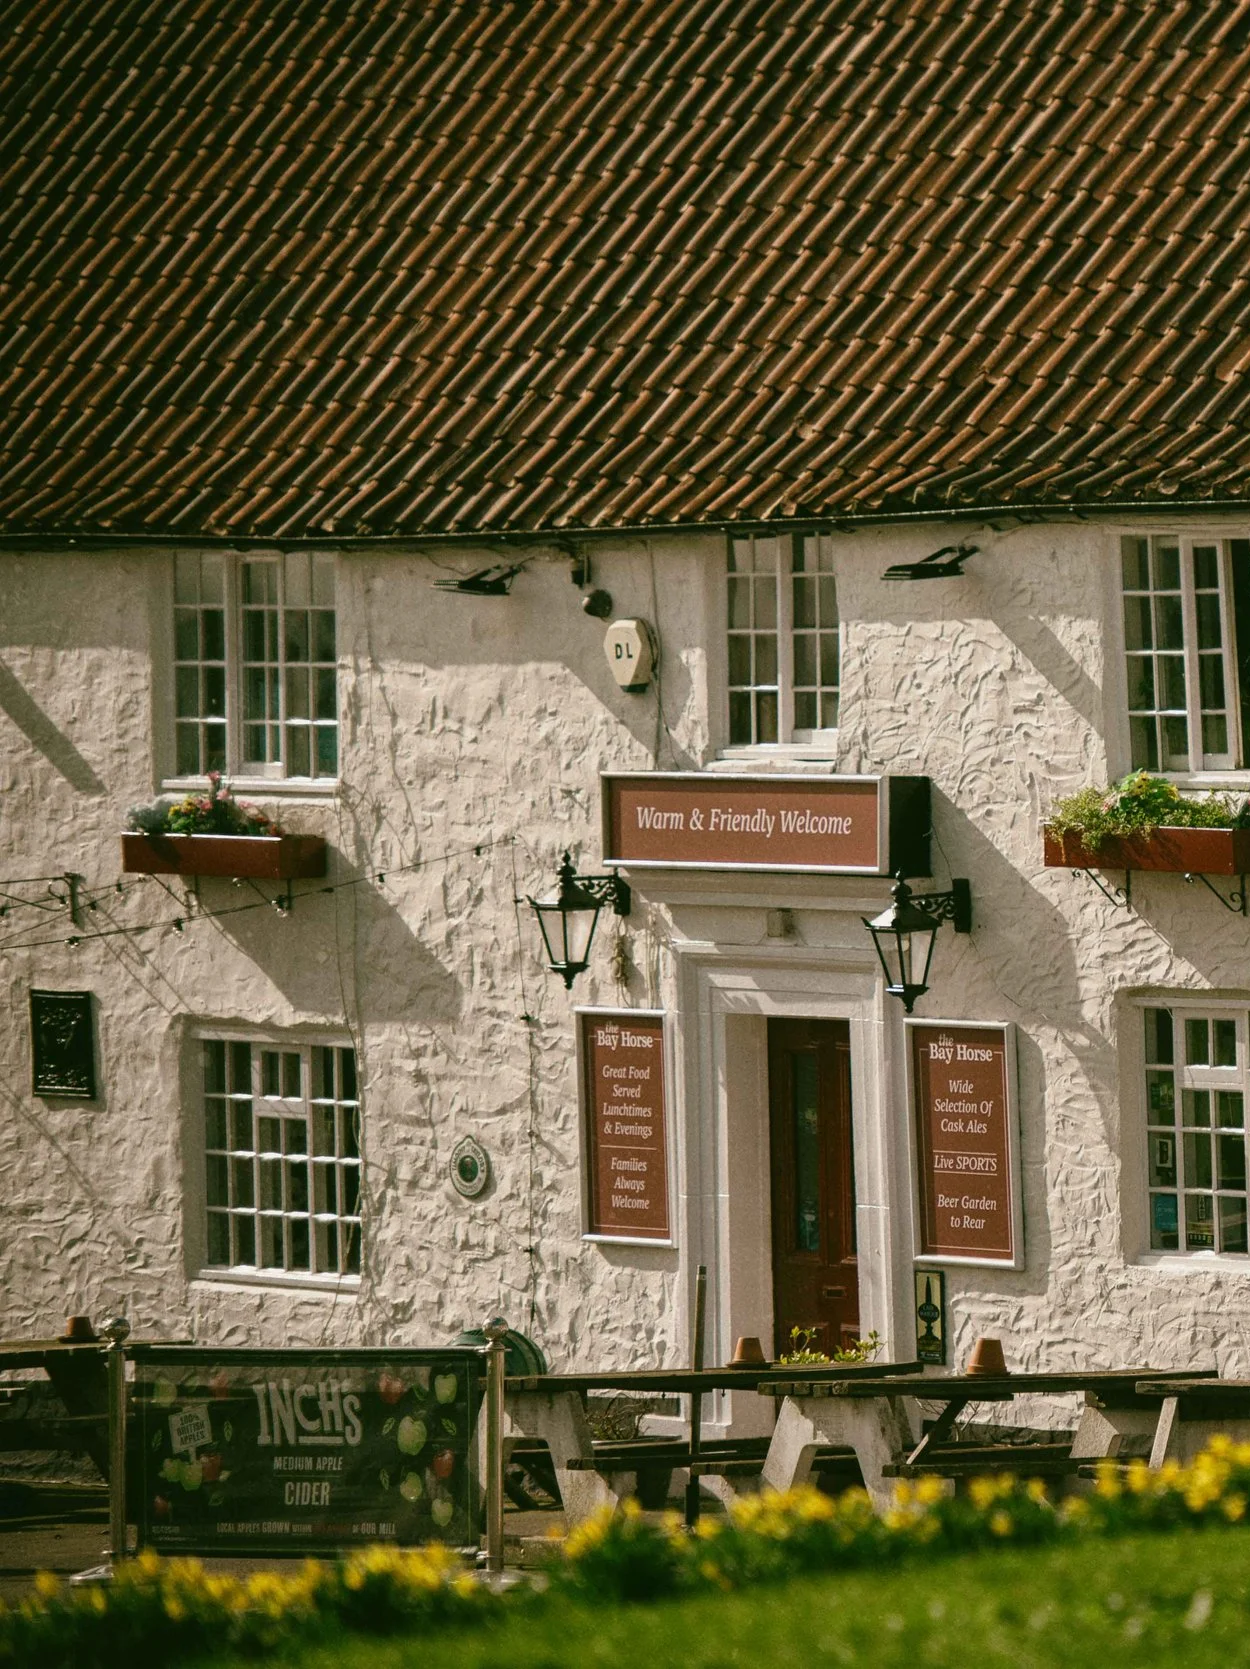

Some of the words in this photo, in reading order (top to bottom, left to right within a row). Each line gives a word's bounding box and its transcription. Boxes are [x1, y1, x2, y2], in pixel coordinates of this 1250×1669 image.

[615, 642, 633, 659] DL
[636, 806, 684, 830] Warm
[689, 808, 704, 831] &
[708, 808, 775, 838] Friendly
[780, 810, 853, 835] Welcome
[606, 1021, 619, 1034] the
[597, 1030, 619, 1051] Bay
[621, 1031, 653, 1048] Horse
[938, 1034, 954, 1047] the
[929, 1043, 954, 1064] Bay
[956, 1044, 993, 1062] Horse
[602, 1065, 627, 1079] Great
[629, 1066, 650, 1079] Food
[612, 1084, 641, 1098] Served
[949, 1080, 974, 1094] Wide
[603, 1102, 652, 1118] Lunchtimes
[934, 1098, 978, 1114] Selection
[980, 1100, 994, 1117] Of
[603, 1121, 612, 1134] &
[614, 1122, 653, 1139] Evenings
[941, 1118, 965, 1133] Cask
[966, 1120, 988, 1134] Ales
[611, 1157, 648, 1171] Families
[934, 1155, 954, 1169] Live
[956, 1156, 997, 1171] SPORTS
[614, 1176, 645, 1193] Always
[611, 1195, 650, 1209] Welcome
[937, 1194, 959, 1208] Beer
[961, 1195, 997, 1211] Garden
[950, 1215, 960, 1228] to
[962, 1215, 986, 1229] Rear
[180, 1431, 205, 1446] APPLES
[273, 1456, 313, 1471] MEDIUM
[316, 1456, 343, 1471] APPLE
[285, 1481, 330, 1506] CIDER
[262, 1521, 290, 1534] GROWN
[379, 1523, 396, 1535] MILL
